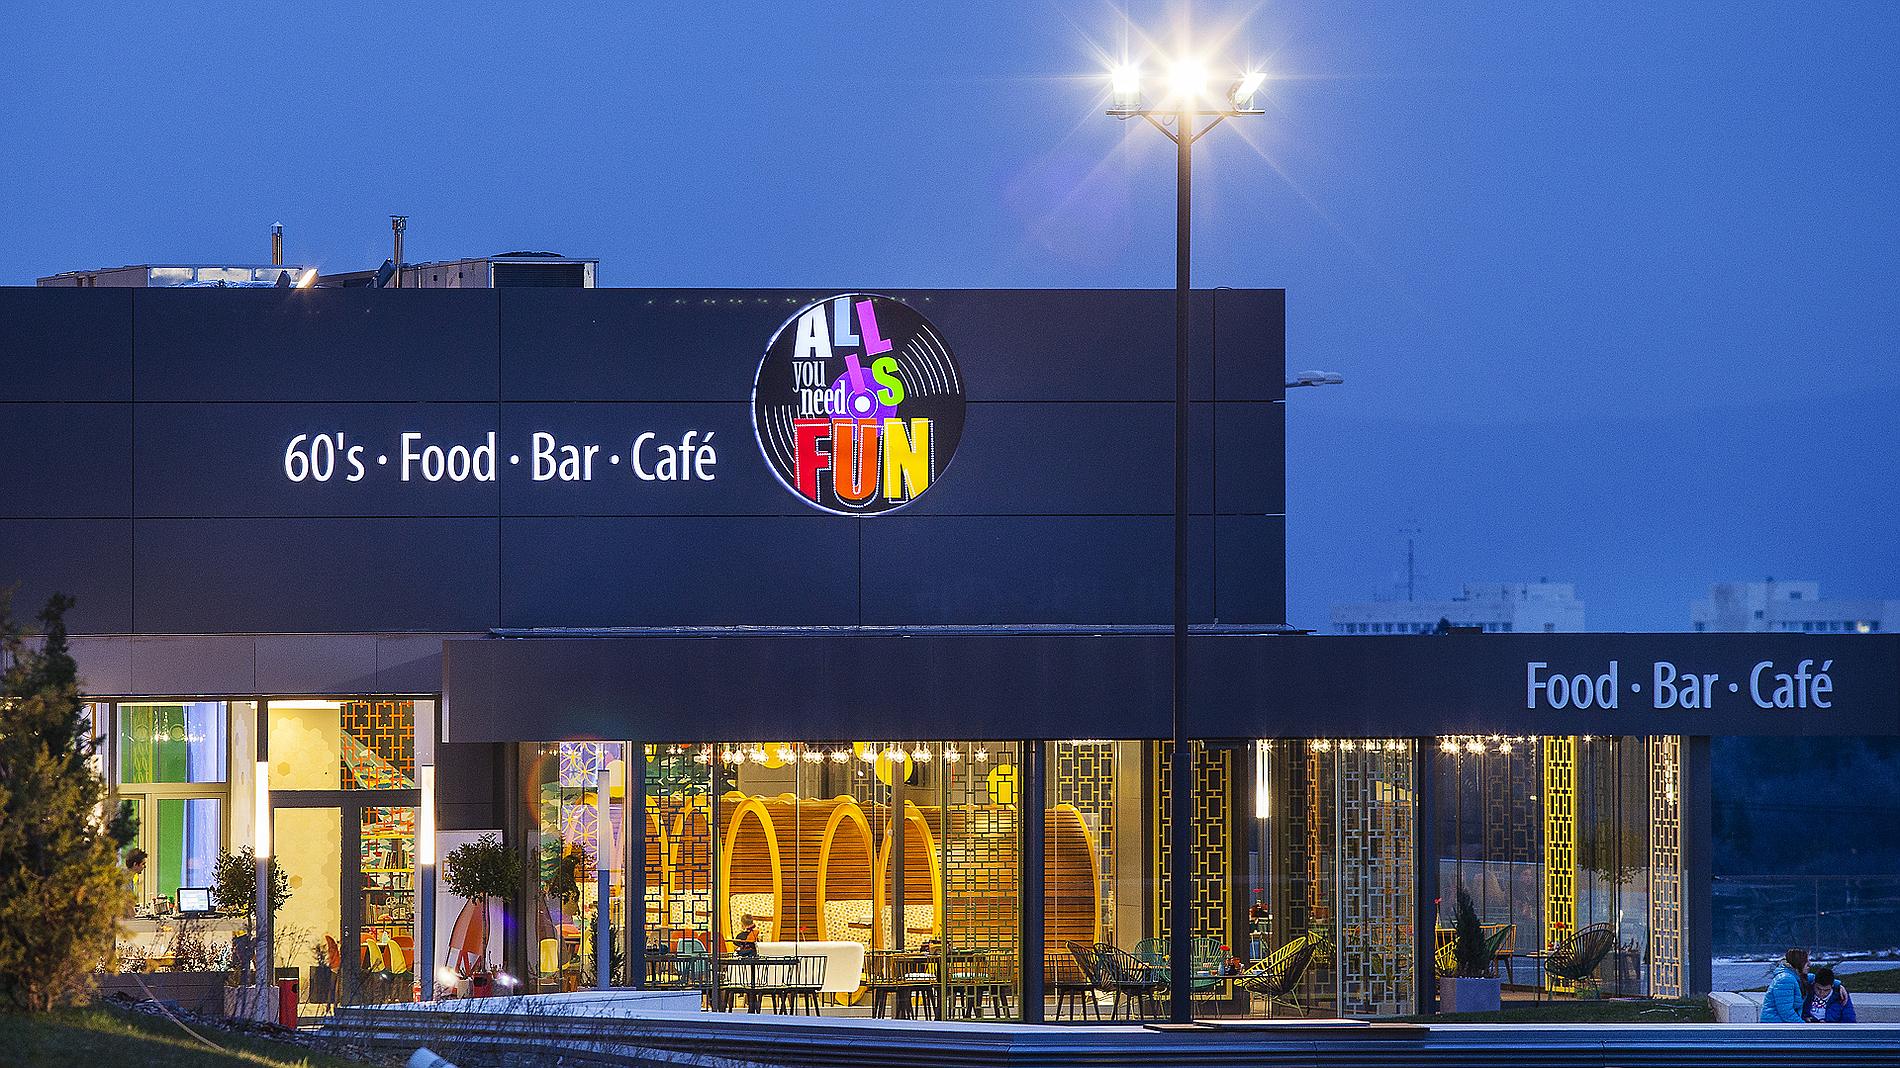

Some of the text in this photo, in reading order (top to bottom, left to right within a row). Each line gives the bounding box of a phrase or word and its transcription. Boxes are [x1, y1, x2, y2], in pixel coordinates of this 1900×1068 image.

[793, 297, 893, 357] ALL
[792, 361, 827, 393] you
[800, 380, 847, 415] need
[844, 353, 905, 406] IS
[284, 430, 717, 482] 60's Food Bar Café
[793, 417, 934, 507] FUN
[1527, 659, 1833, 709] Food Bar Café
